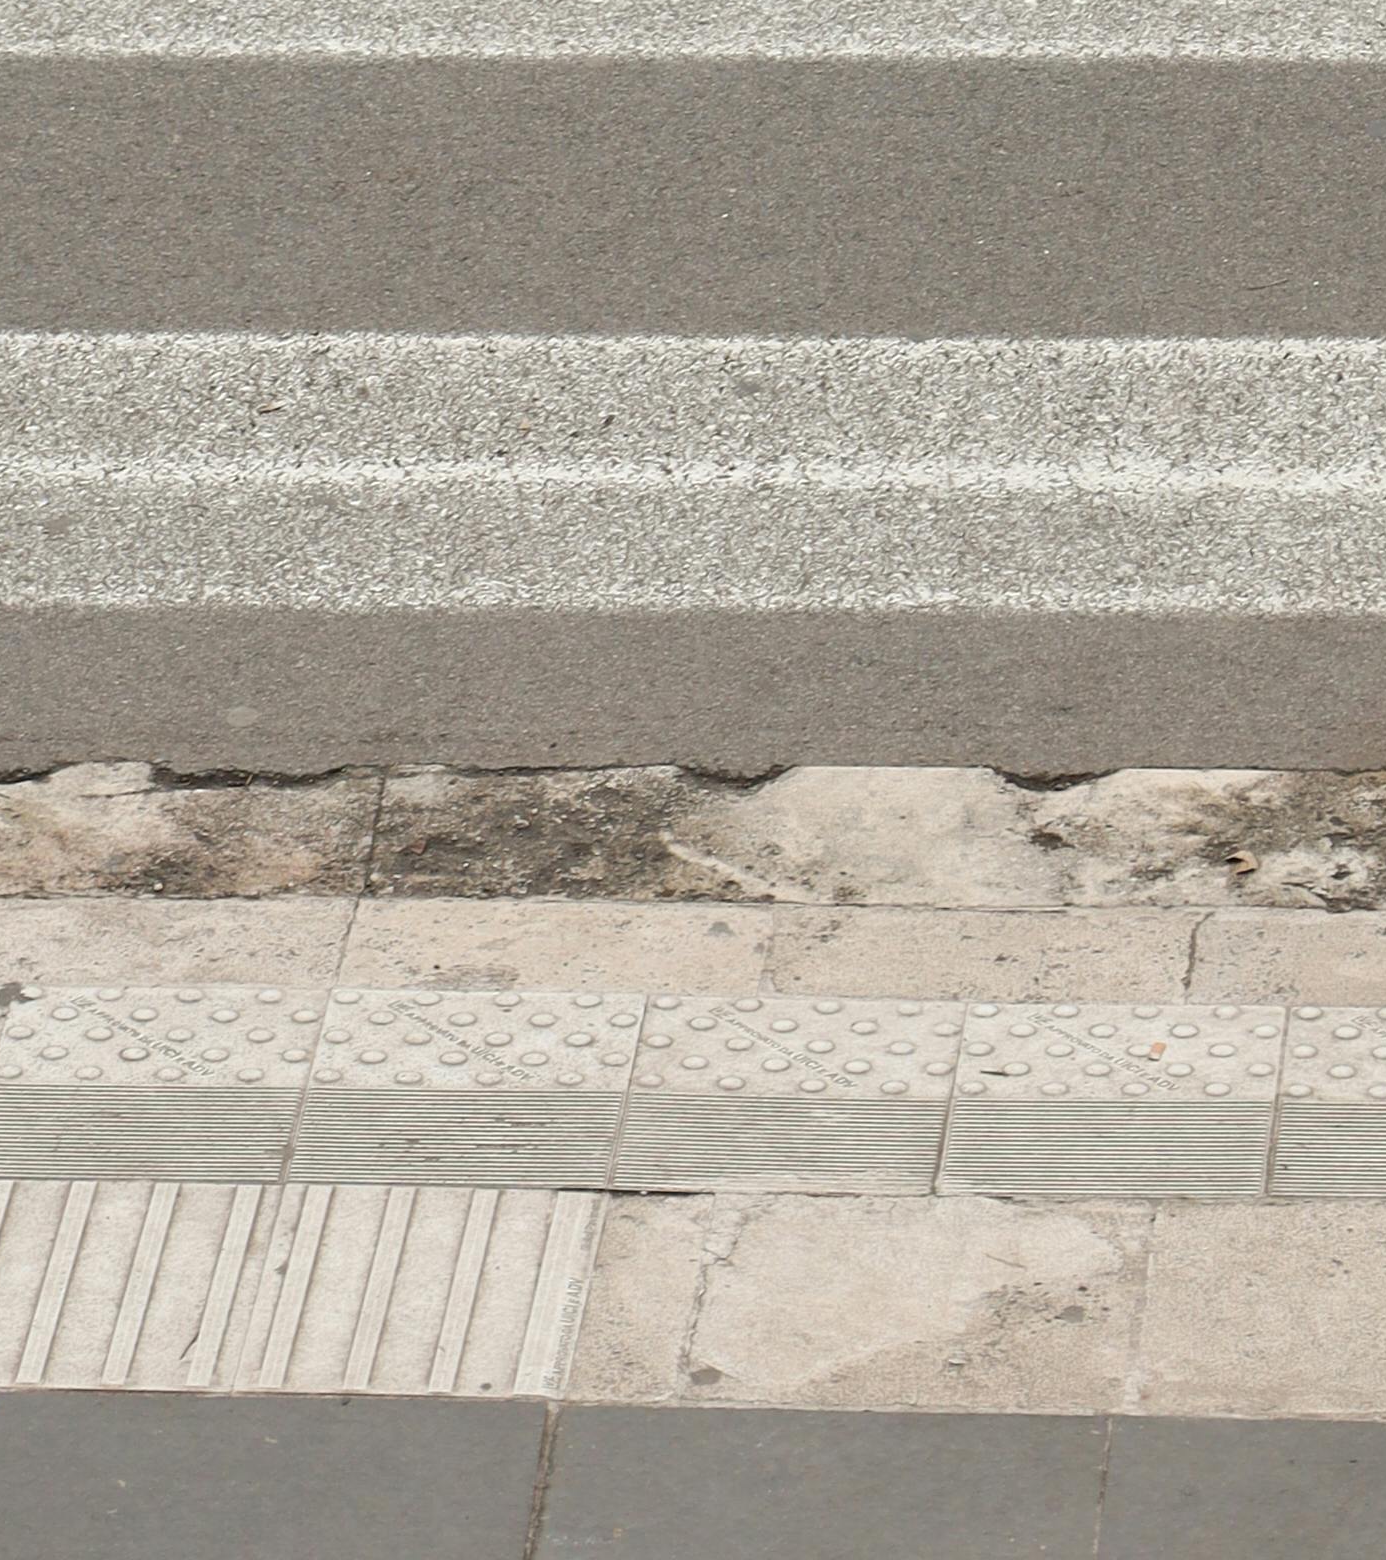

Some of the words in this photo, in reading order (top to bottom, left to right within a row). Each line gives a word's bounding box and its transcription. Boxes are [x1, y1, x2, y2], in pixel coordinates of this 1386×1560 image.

[1114, 1058, 1143, 1077] UICI
[1147, 1074, 1181, 1091] ADV
[566, 1278, 584, 1298] ADV
